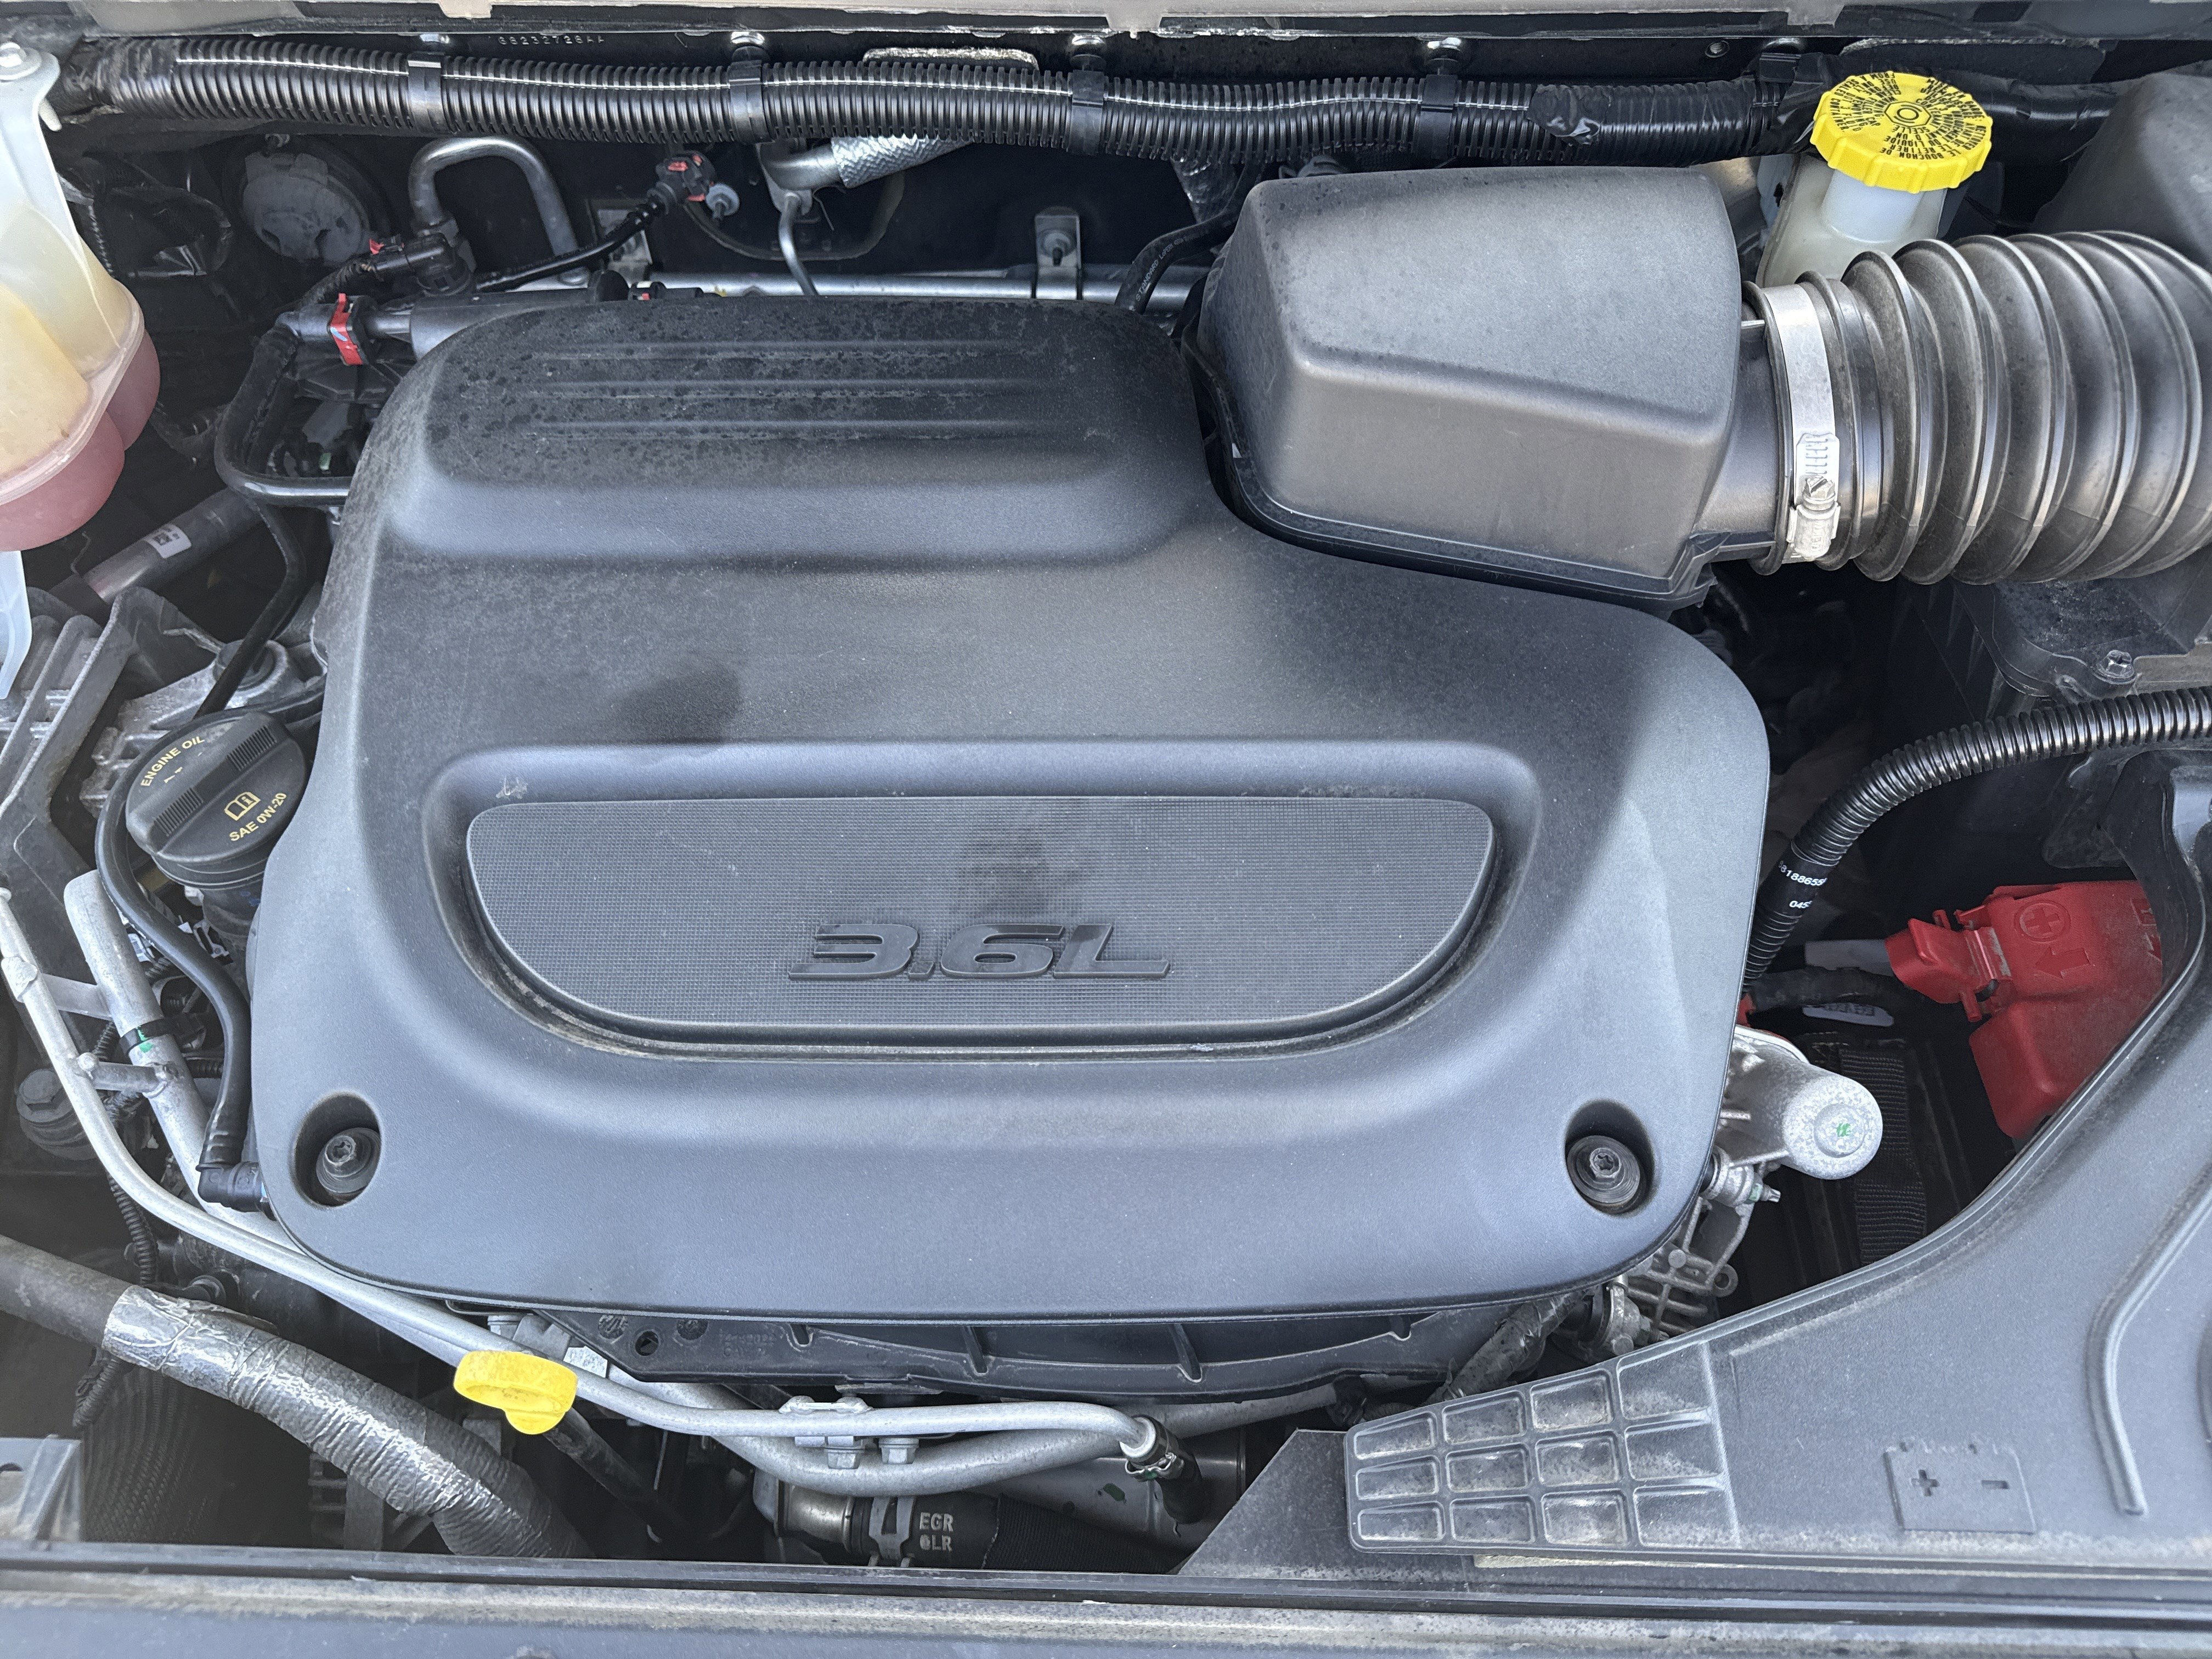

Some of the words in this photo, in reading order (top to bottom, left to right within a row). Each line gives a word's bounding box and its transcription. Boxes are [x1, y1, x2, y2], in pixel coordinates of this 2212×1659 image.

[1834, 79, 1859, 97] SEALED
[1853, 81, 1875, 93] ONLY
[1862, 84, 1899, 96] BEFORE
[1875, 89, 1901, 99] CLEAN
[1953, 91, 1966, 99] EN
[1842, 92, 1855, 103] DOT
[1862, 97, 1878, 114] FILLER
[1925, 95, 1942, 106] DOT
[1865, 117, 1881, 126] CAP
[1916, 98, 1942, 129] CONTENANT
[1841, 113, 1862, 132] FLUID
[1925, 114, 1954, 139] PROVENANT
[1941, 111, 1963, 143] UNIQUEMENT
[1962, 122, 1976, 140] AVANT
[1883, 136, 1925, 147] LIQUIDE
[1950, 138, 1964, 147] DE
[1962, 125, 1987, 150] NETTOYER
[1879, 147, 1892, 155] DE
[1938, 144, 1953, 152] LE
[1946, 149, 1962, 157] LE
[1135, 259, 1159, 302] STANDARD
[140, 747, 181, 786] ENGINE
[182, 736, 205, 749] OIL
[229, 821, 259, 841] SAE
[257, 793, 287, 823] 0W-20
[1778, 860, 1827, 886] 8188655
[789, 923, 1171, 981] 3.6L
[919, 1511, 953, 1532] EGR
